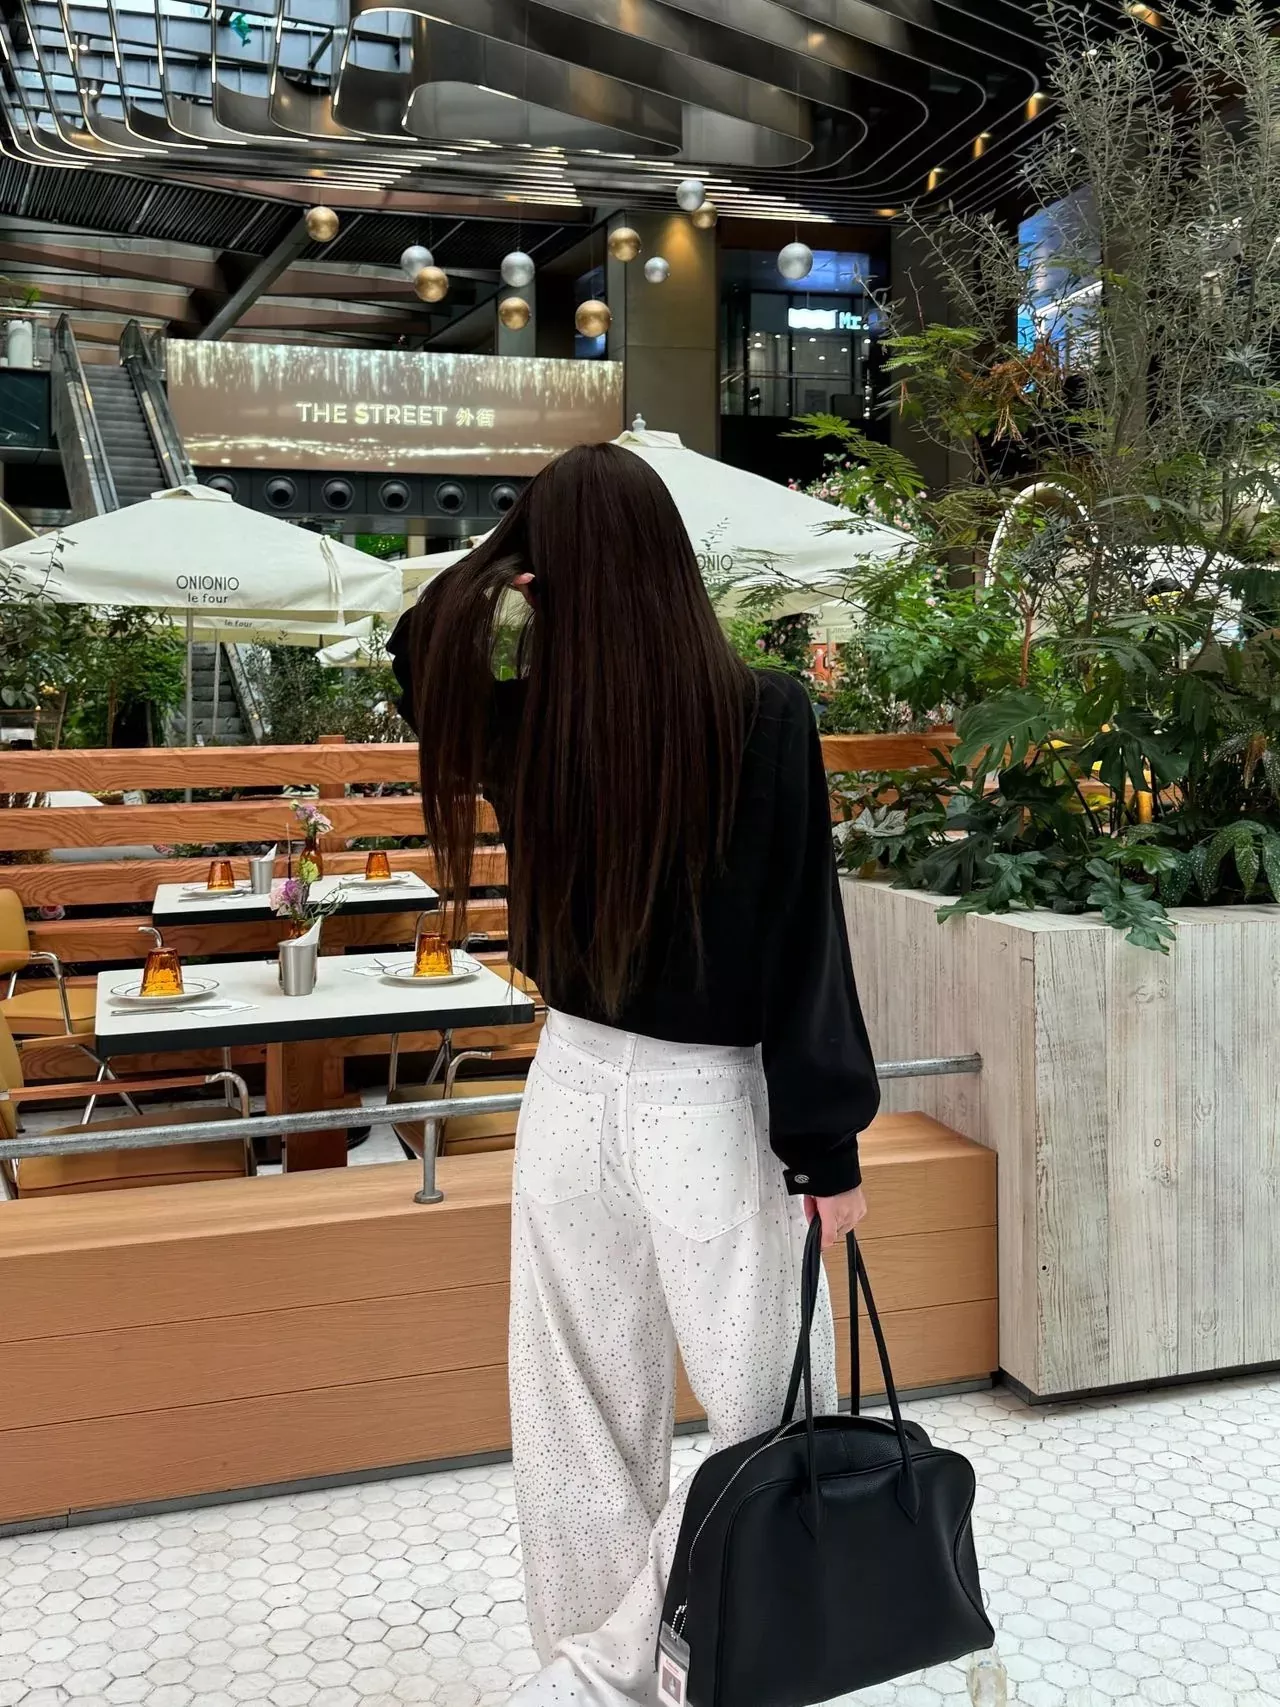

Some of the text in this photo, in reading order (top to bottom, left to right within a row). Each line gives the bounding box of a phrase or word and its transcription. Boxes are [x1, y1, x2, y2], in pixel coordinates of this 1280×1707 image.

[296, 402, 495, 428] THE STREET 外街
[176, 575, 239, 591] ONIONIO
[187, 593, 228, 604] le four
[235, 620, 253, 628] four
